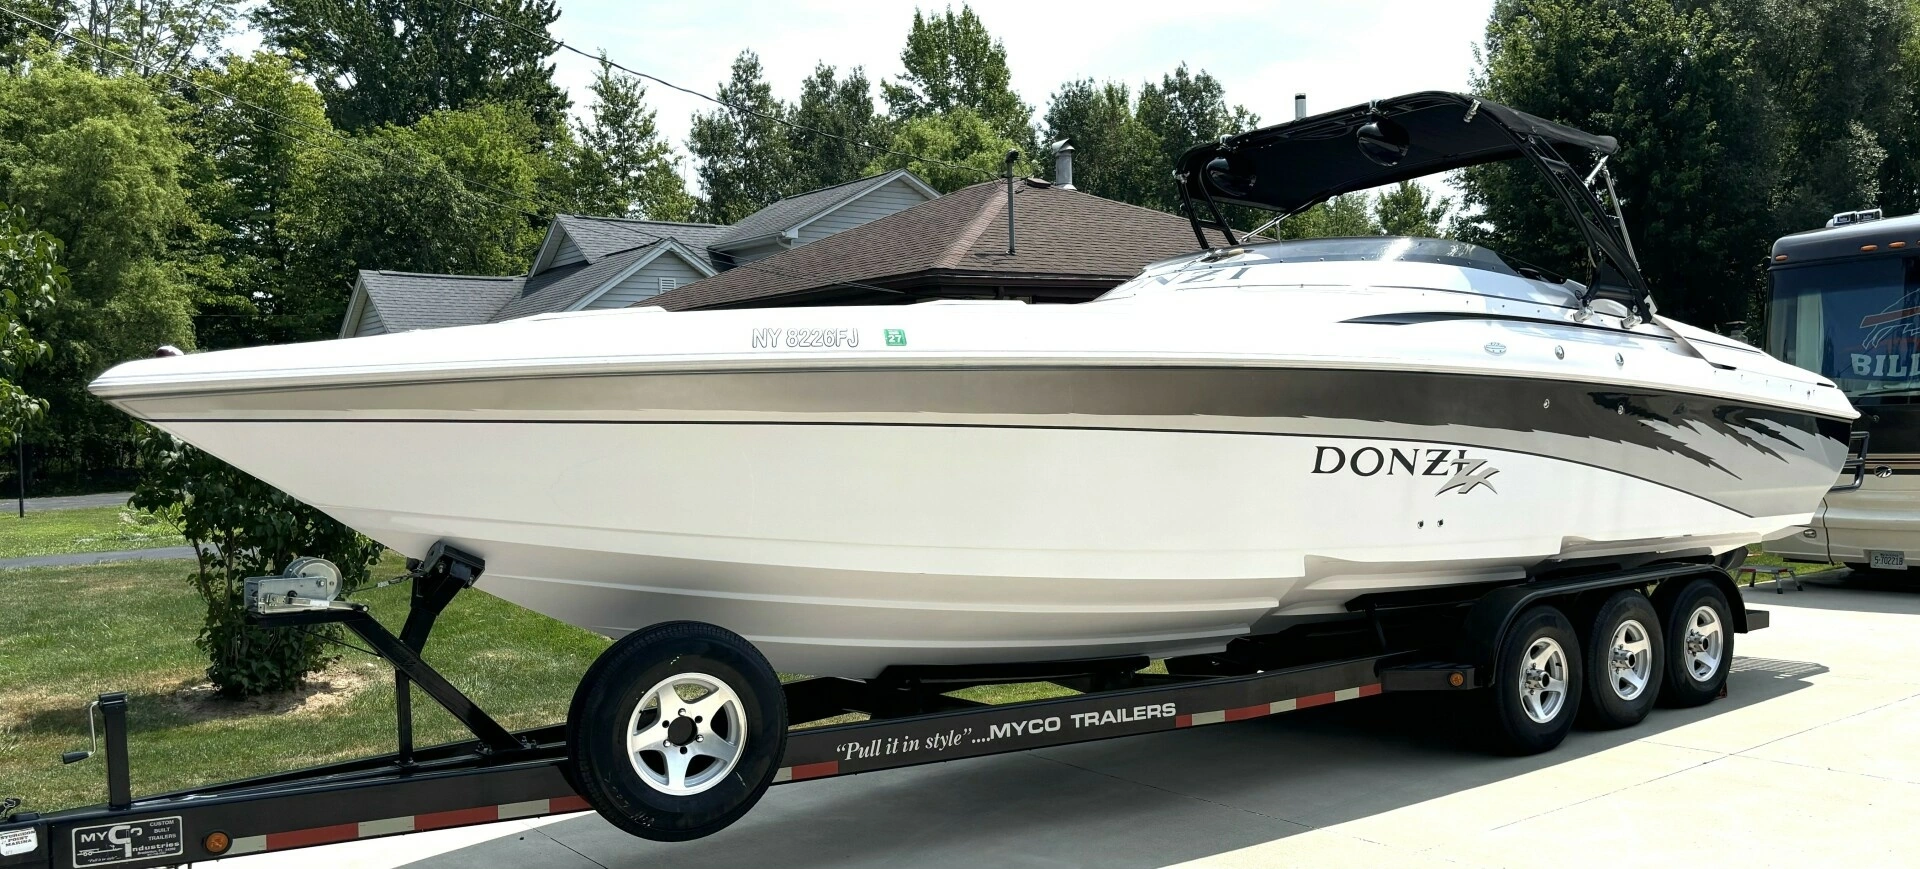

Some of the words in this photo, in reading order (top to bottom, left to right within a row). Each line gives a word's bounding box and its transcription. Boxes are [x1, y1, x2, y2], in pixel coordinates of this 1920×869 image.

[752, 328, 782, 348] NY
[786, 328, 859, 348] 8226FJ
[887, 334, 902, 343] 27
[885, 737, 899, 755] it
[902, 735, 920, 753] in
[1071, 702, 1176, 728] TRAILERS
[149, 819, 175, 827] CUSTOM
[148, 833, 177, 841] TRAILERS
